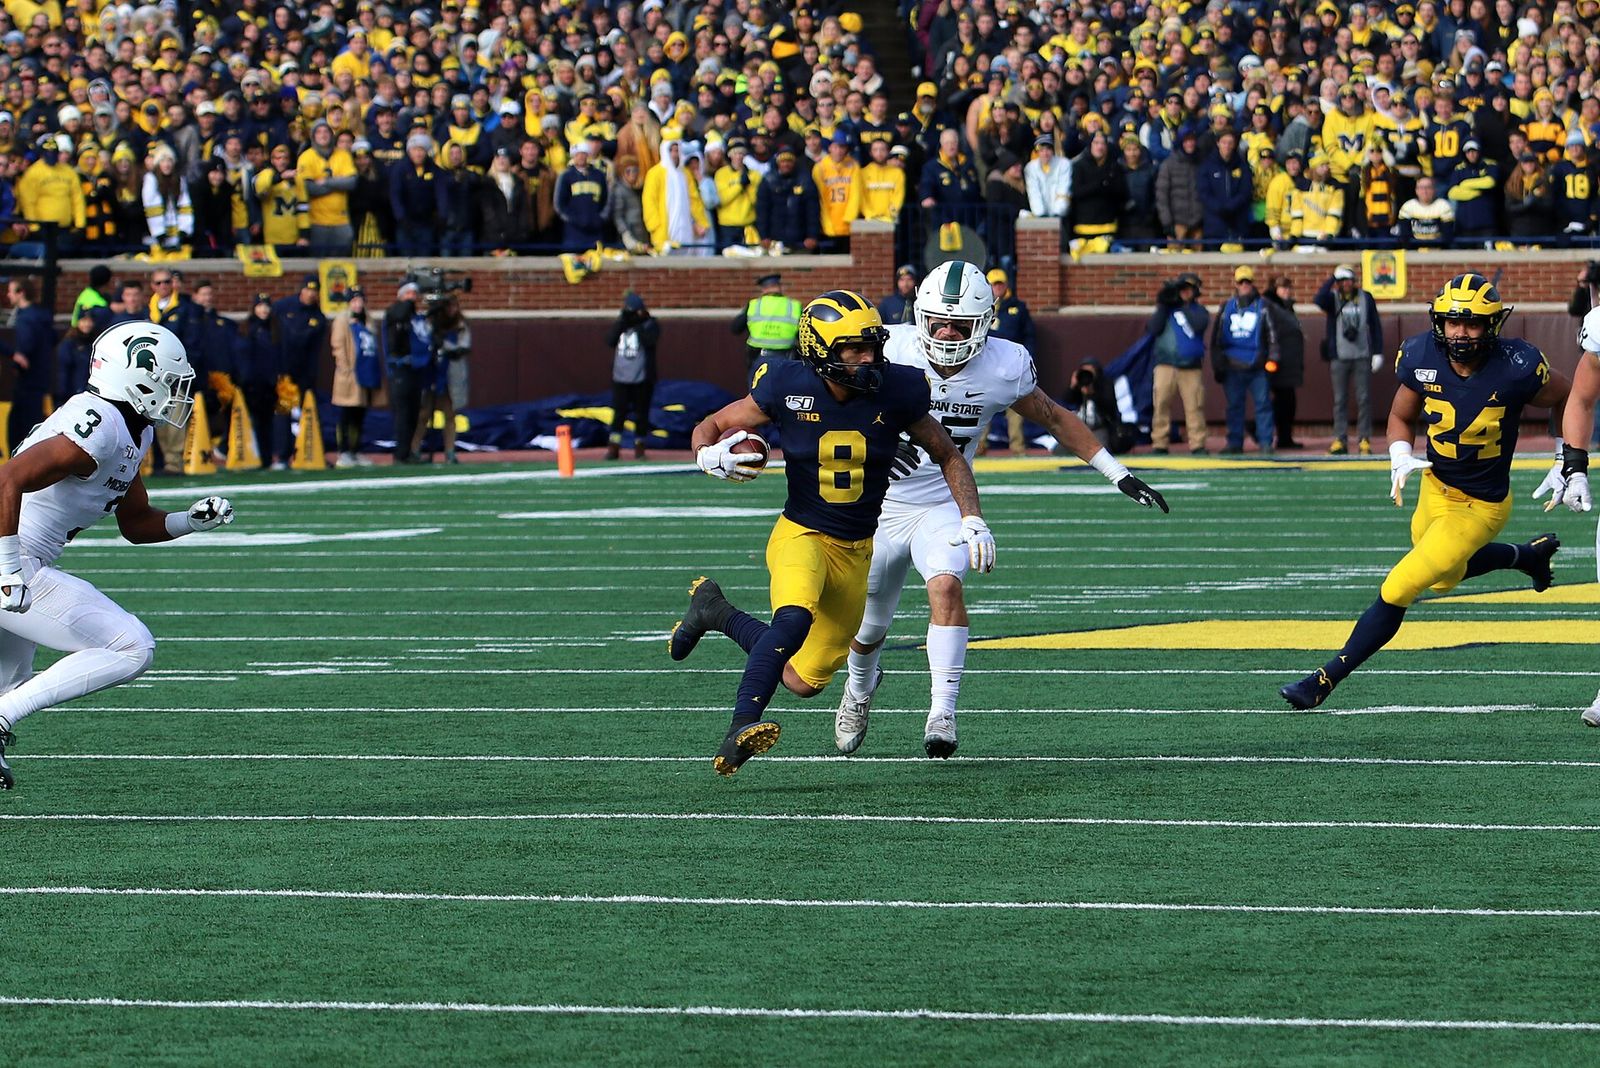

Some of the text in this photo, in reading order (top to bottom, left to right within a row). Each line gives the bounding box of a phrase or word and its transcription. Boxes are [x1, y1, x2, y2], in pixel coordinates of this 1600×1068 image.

[1338, 133, 1364, 153] M
[1434, 129, 1459, 158] 10
[274, 197, 297, 215] M
[1414, 369, 1437, 382] 150
[784, 395, 815, 411] 150
[951, 403, 984, 415] STATE
[74, 409, 102, 438] 3
[1423, 397, 1506, 460] 24
[818, 430, 866, 503] 8
